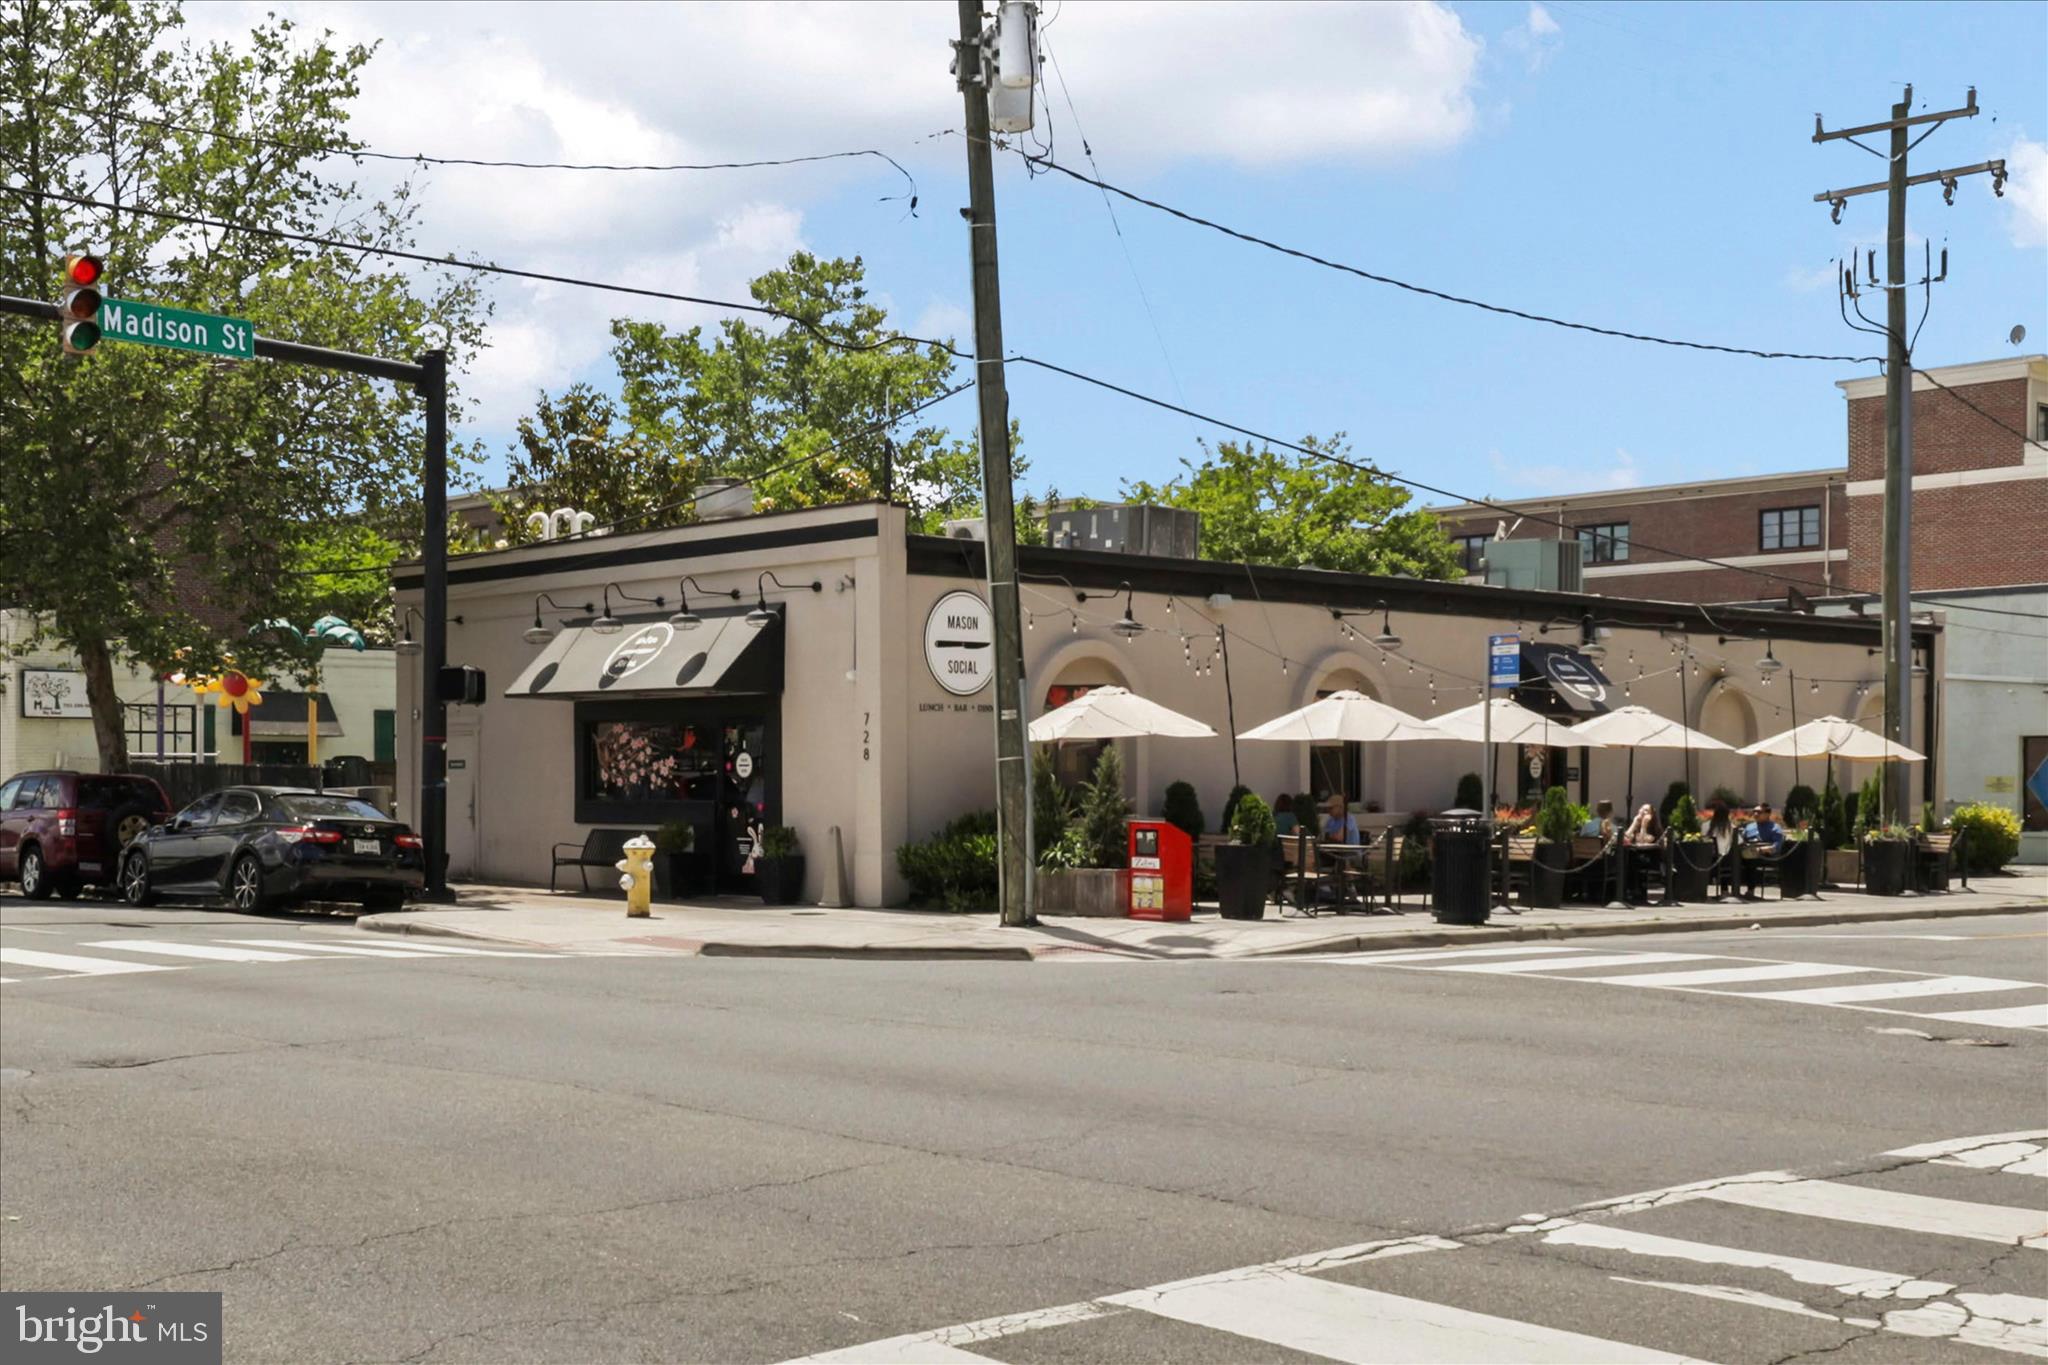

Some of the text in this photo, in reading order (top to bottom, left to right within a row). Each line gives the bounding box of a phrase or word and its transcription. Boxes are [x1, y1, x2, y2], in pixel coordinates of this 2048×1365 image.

[104, 304, 246, 351] Madison St
[947, 615, 979, 630] MASON
[947, 660, 978, 675] SOCIAL
[919, 703, 944, 712] LUNCH
[953, 703, 968, 712] BAR
